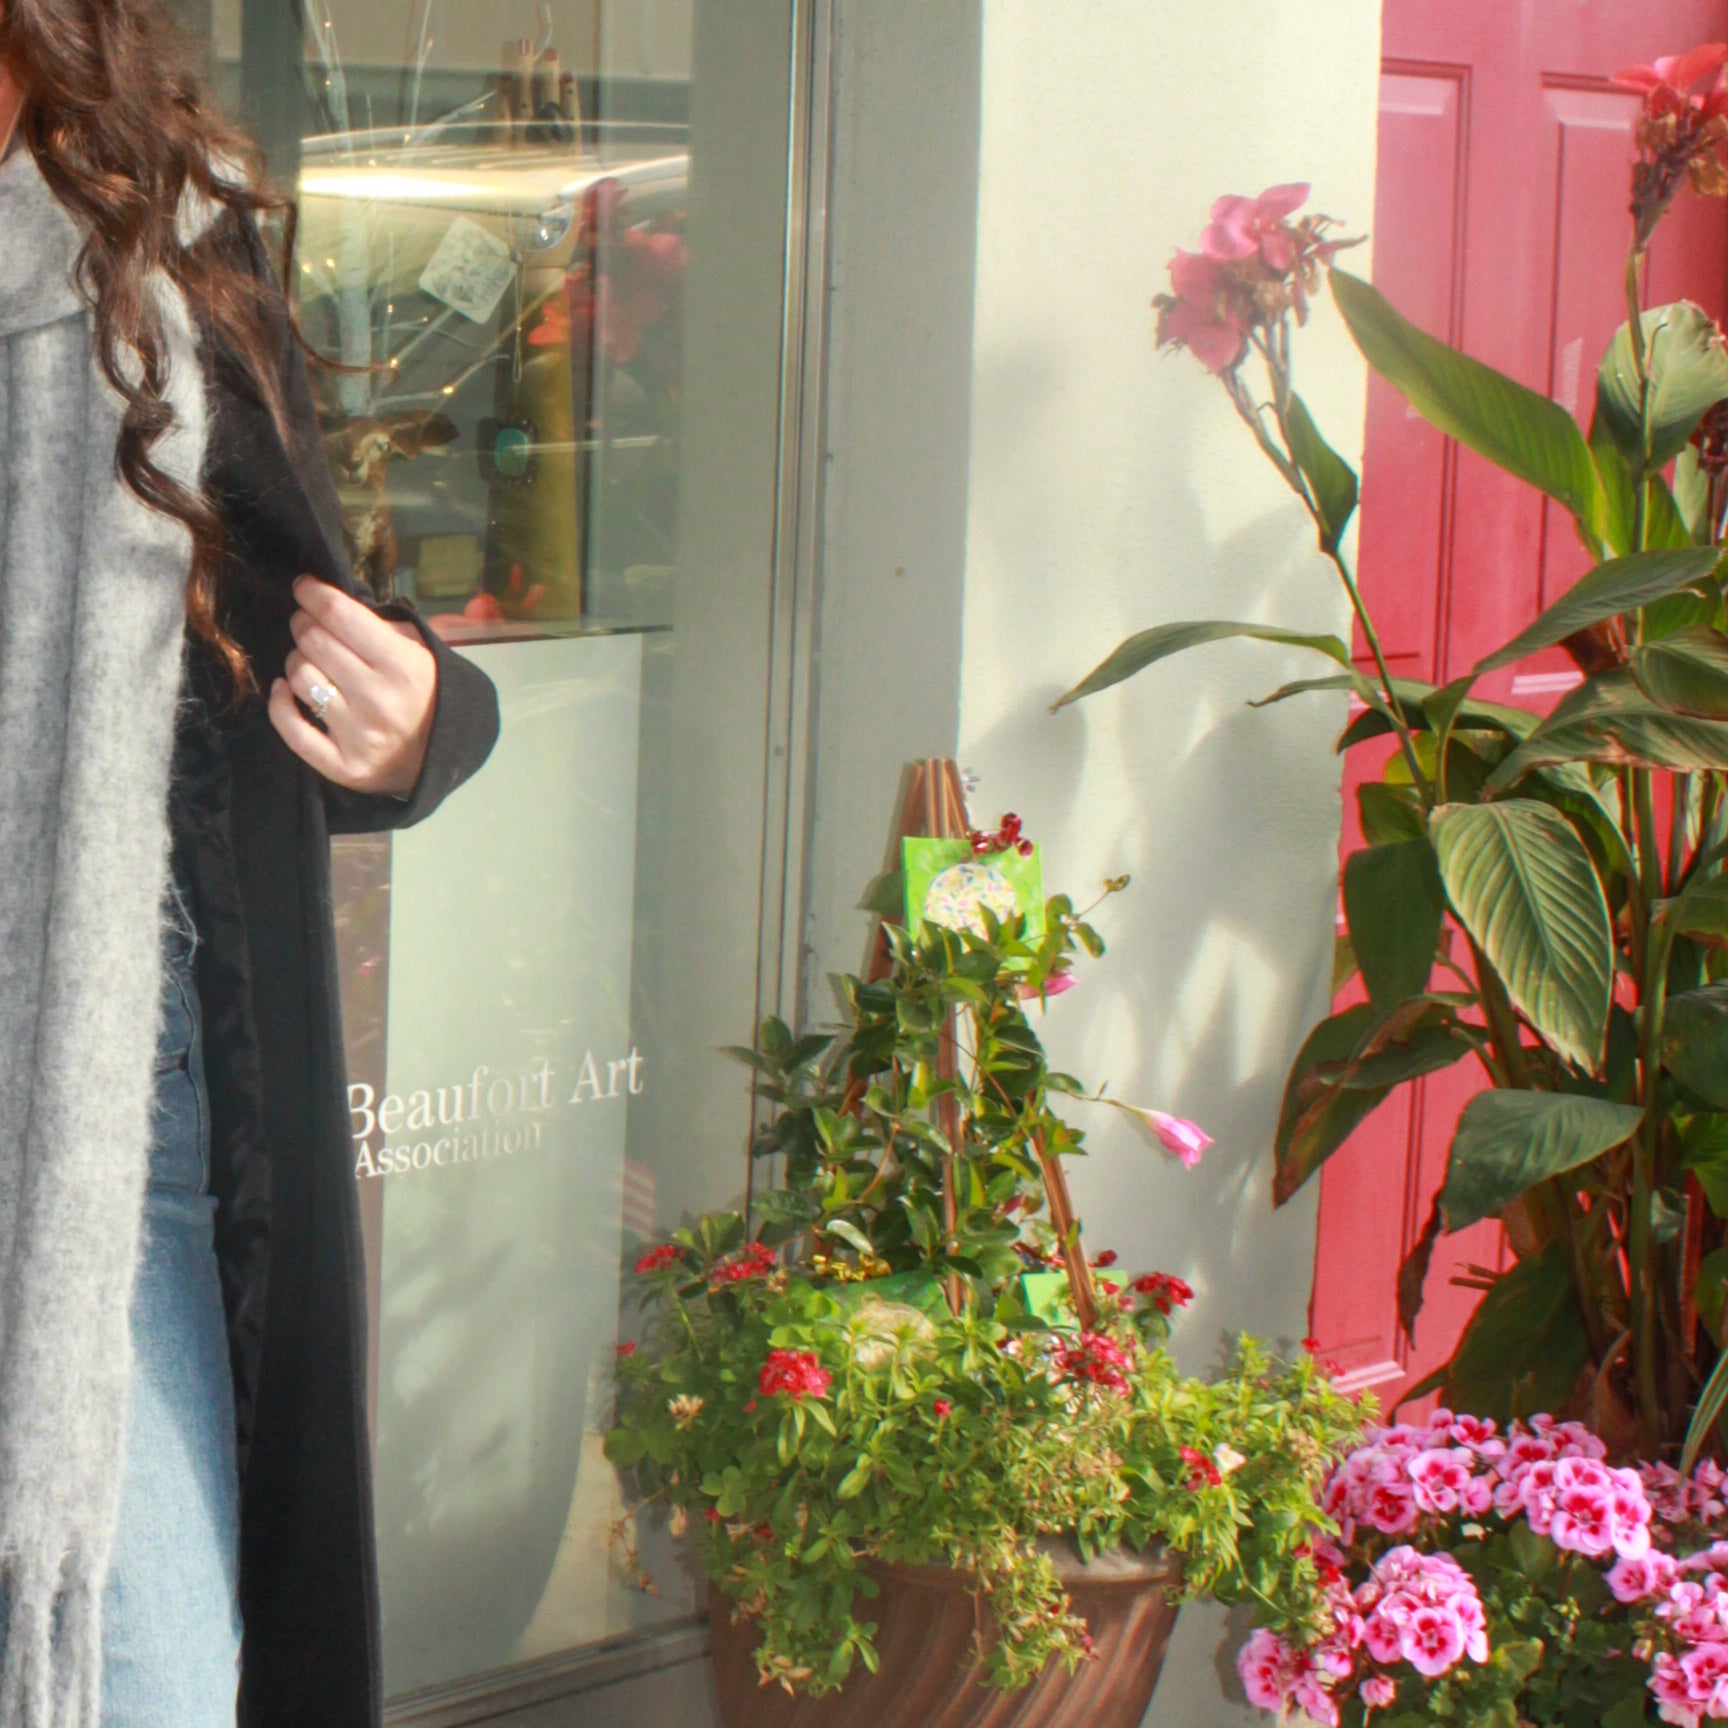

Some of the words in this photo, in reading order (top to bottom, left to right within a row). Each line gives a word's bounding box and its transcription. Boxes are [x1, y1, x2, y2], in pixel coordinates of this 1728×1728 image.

[347, 1060, 556, 1139] Beaufort
[568, 1046, 644, 1104] Art
[354, 1120, 544, 1179] Association
